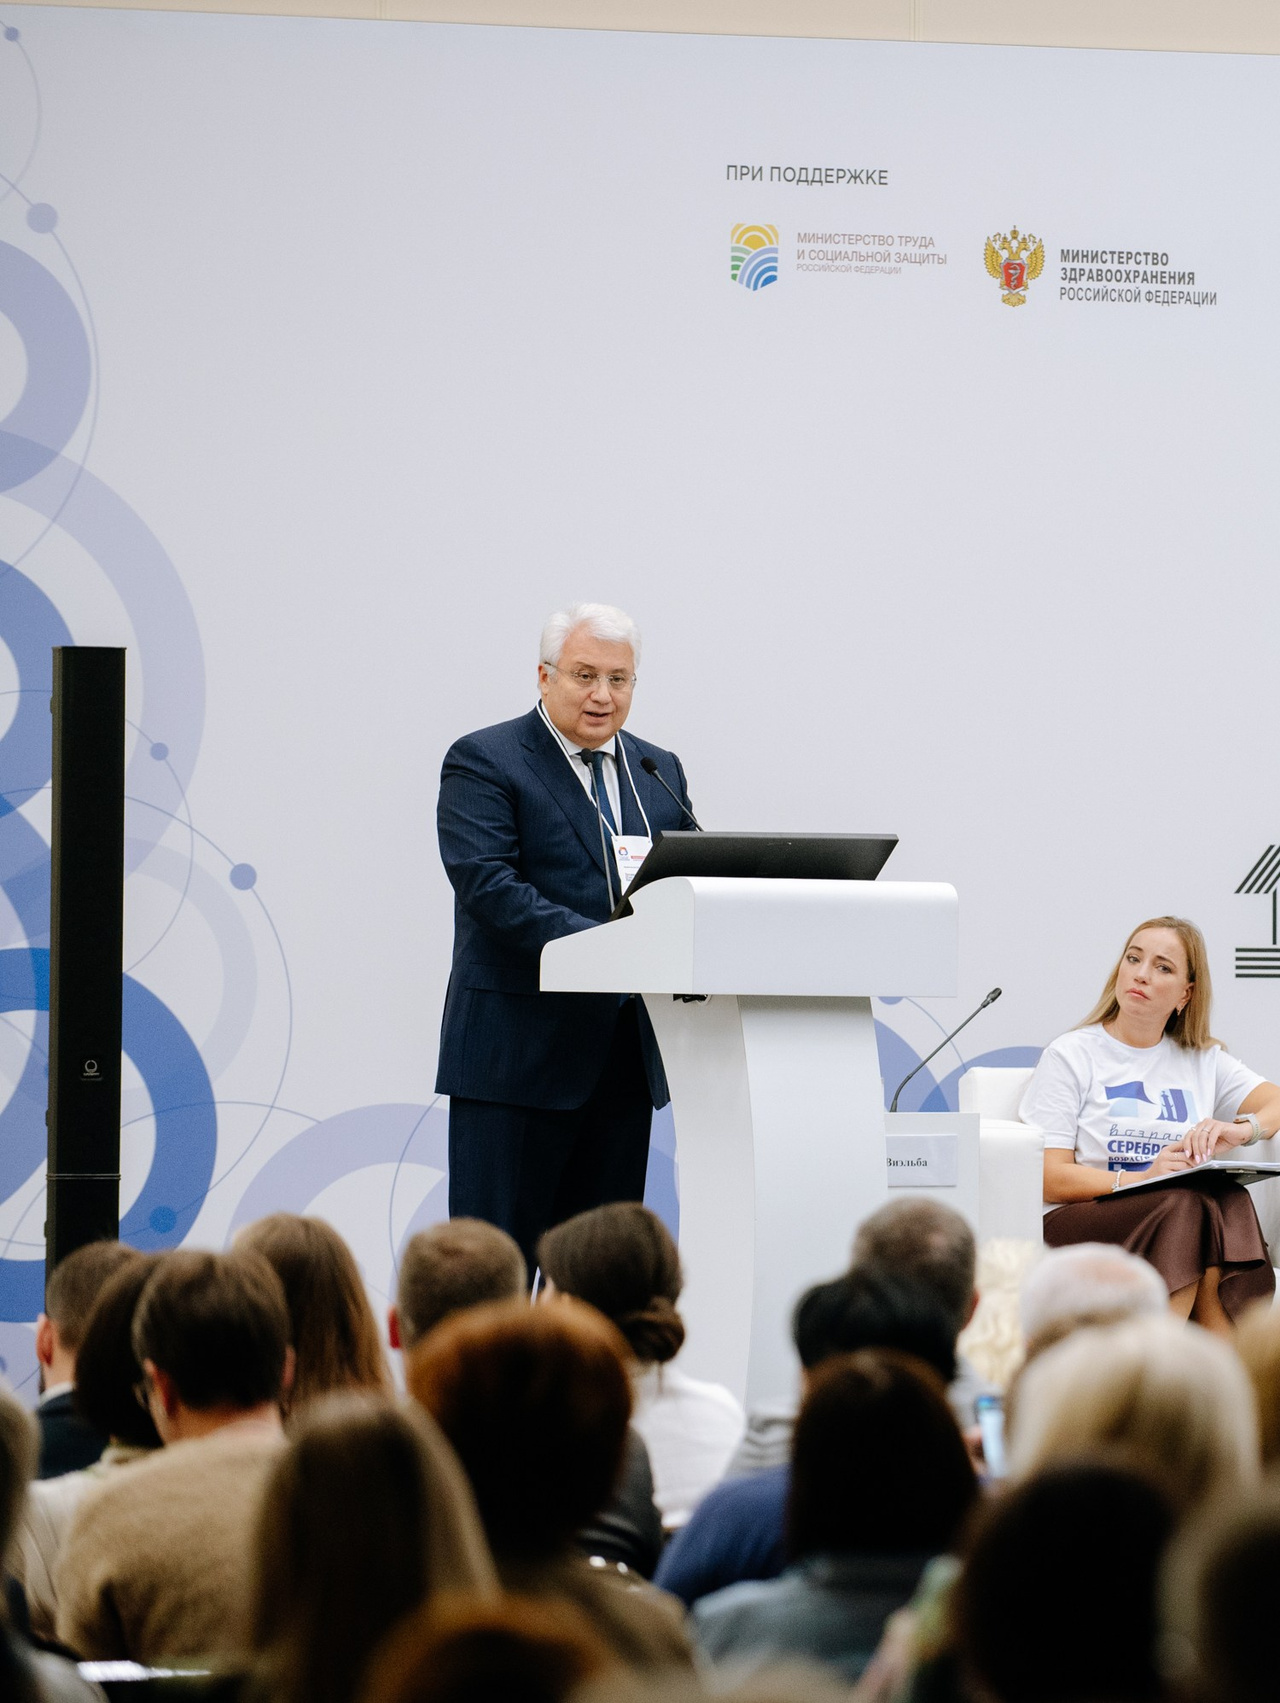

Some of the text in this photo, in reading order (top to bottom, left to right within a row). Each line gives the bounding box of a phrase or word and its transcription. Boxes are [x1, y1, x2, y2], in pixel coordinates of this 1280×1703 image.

[726, 164, 889, 187] ПРИ ПОДДЕРЖКЕ
[796, 232, 936, 250] МИНИСТЕРСТВО ТРУДА
[796, 249, 948, 266] И СОЦИАЛЬНОЙ ЗАЩИТЫ
[1060, 249, 1169, 266] МИНИСТЕРСТВО
[796, 263, 902, 275] РОССИЙСКОЙ ФЕДЕРАЦИИ
[1060, 267, 1196, 286] ЗДРАВООХРАНЕНИЯ
[1059, 285, 1218, 308] РОССИЙСКОЙ ФЕДЕРАЦИИ
[1107, 1139, 1169, 1157] СЕРЕБР
